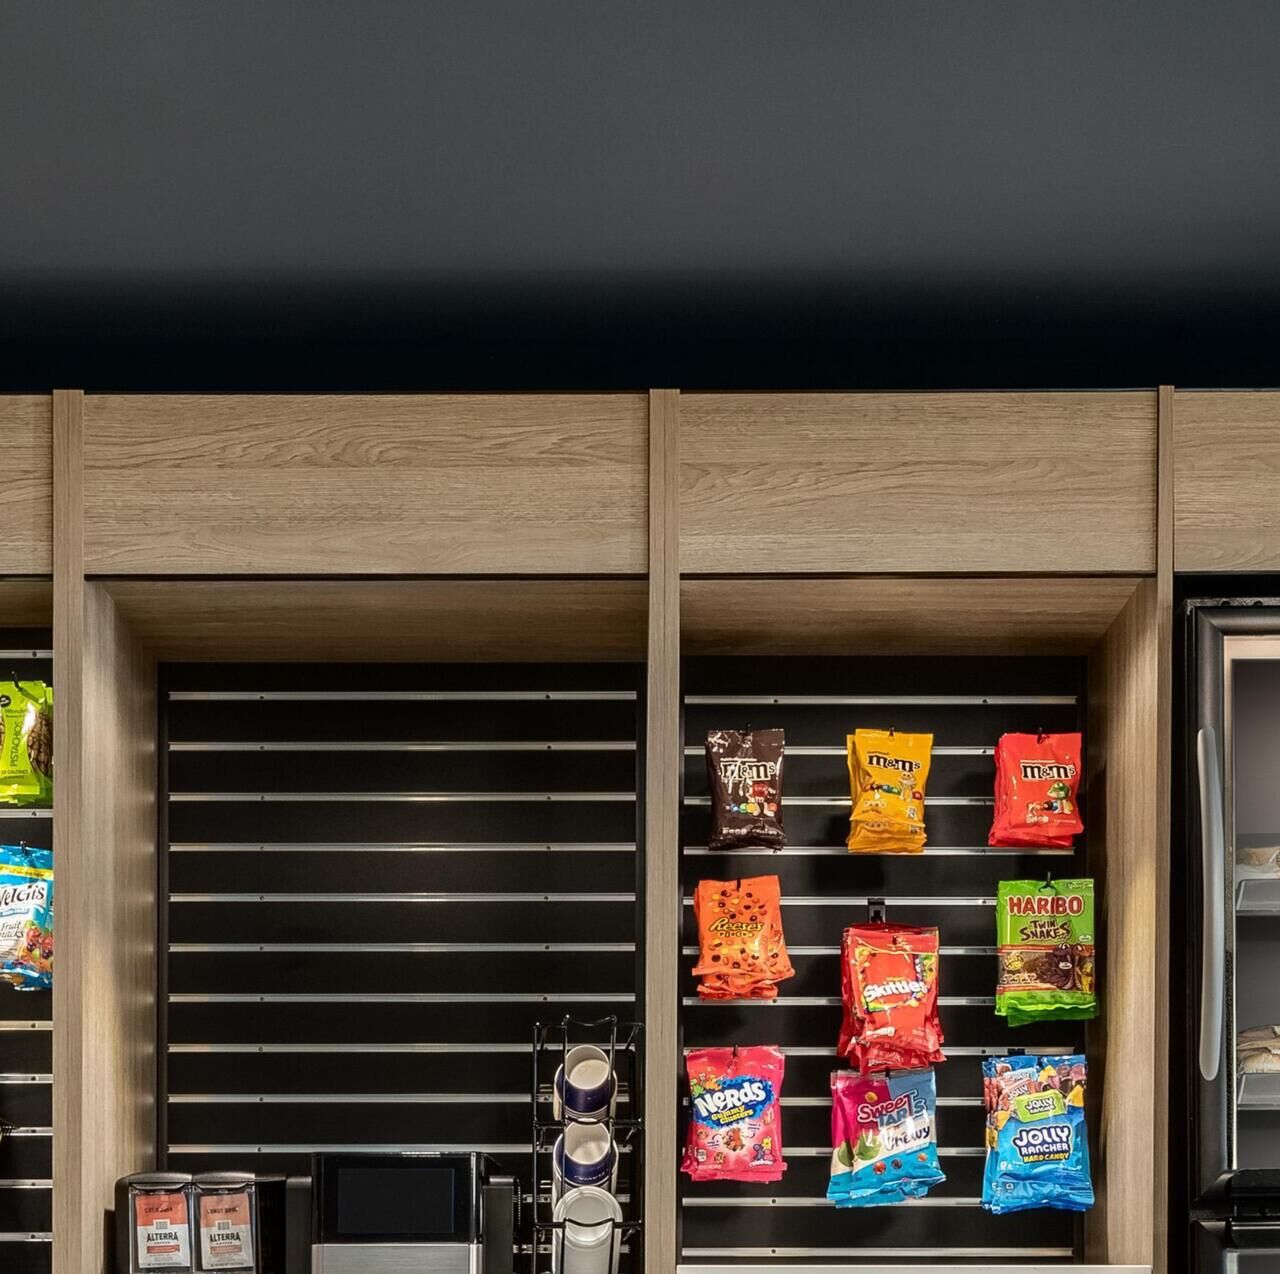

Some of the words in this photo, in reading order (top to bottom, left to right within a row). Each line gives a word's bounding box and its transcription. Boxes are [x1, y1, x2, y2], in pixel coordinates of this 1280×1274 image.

[1007, 895, 1083, 917] HARIBO
[709, 917, 764, 932] Reese's
[1030, 920, 1058, 931] TWIN
[1020, 922, 1071, 942] SNAKES
[863, 980, 929, 999] Skittles
[1025, 1097, 1054, 1109] JOLLY
[1015, 1126, 1071, 1146] JOLLY
[1021, 1141, 1070, 1155] RANCHER
[1023, 1154, 1044, 1163] HARD
[1044, 1152, 1070, 1162] CANDY
[146, 1232, 178, 1243] ALTERRA
[210, 1231, 241, 1243] ALTERRA
